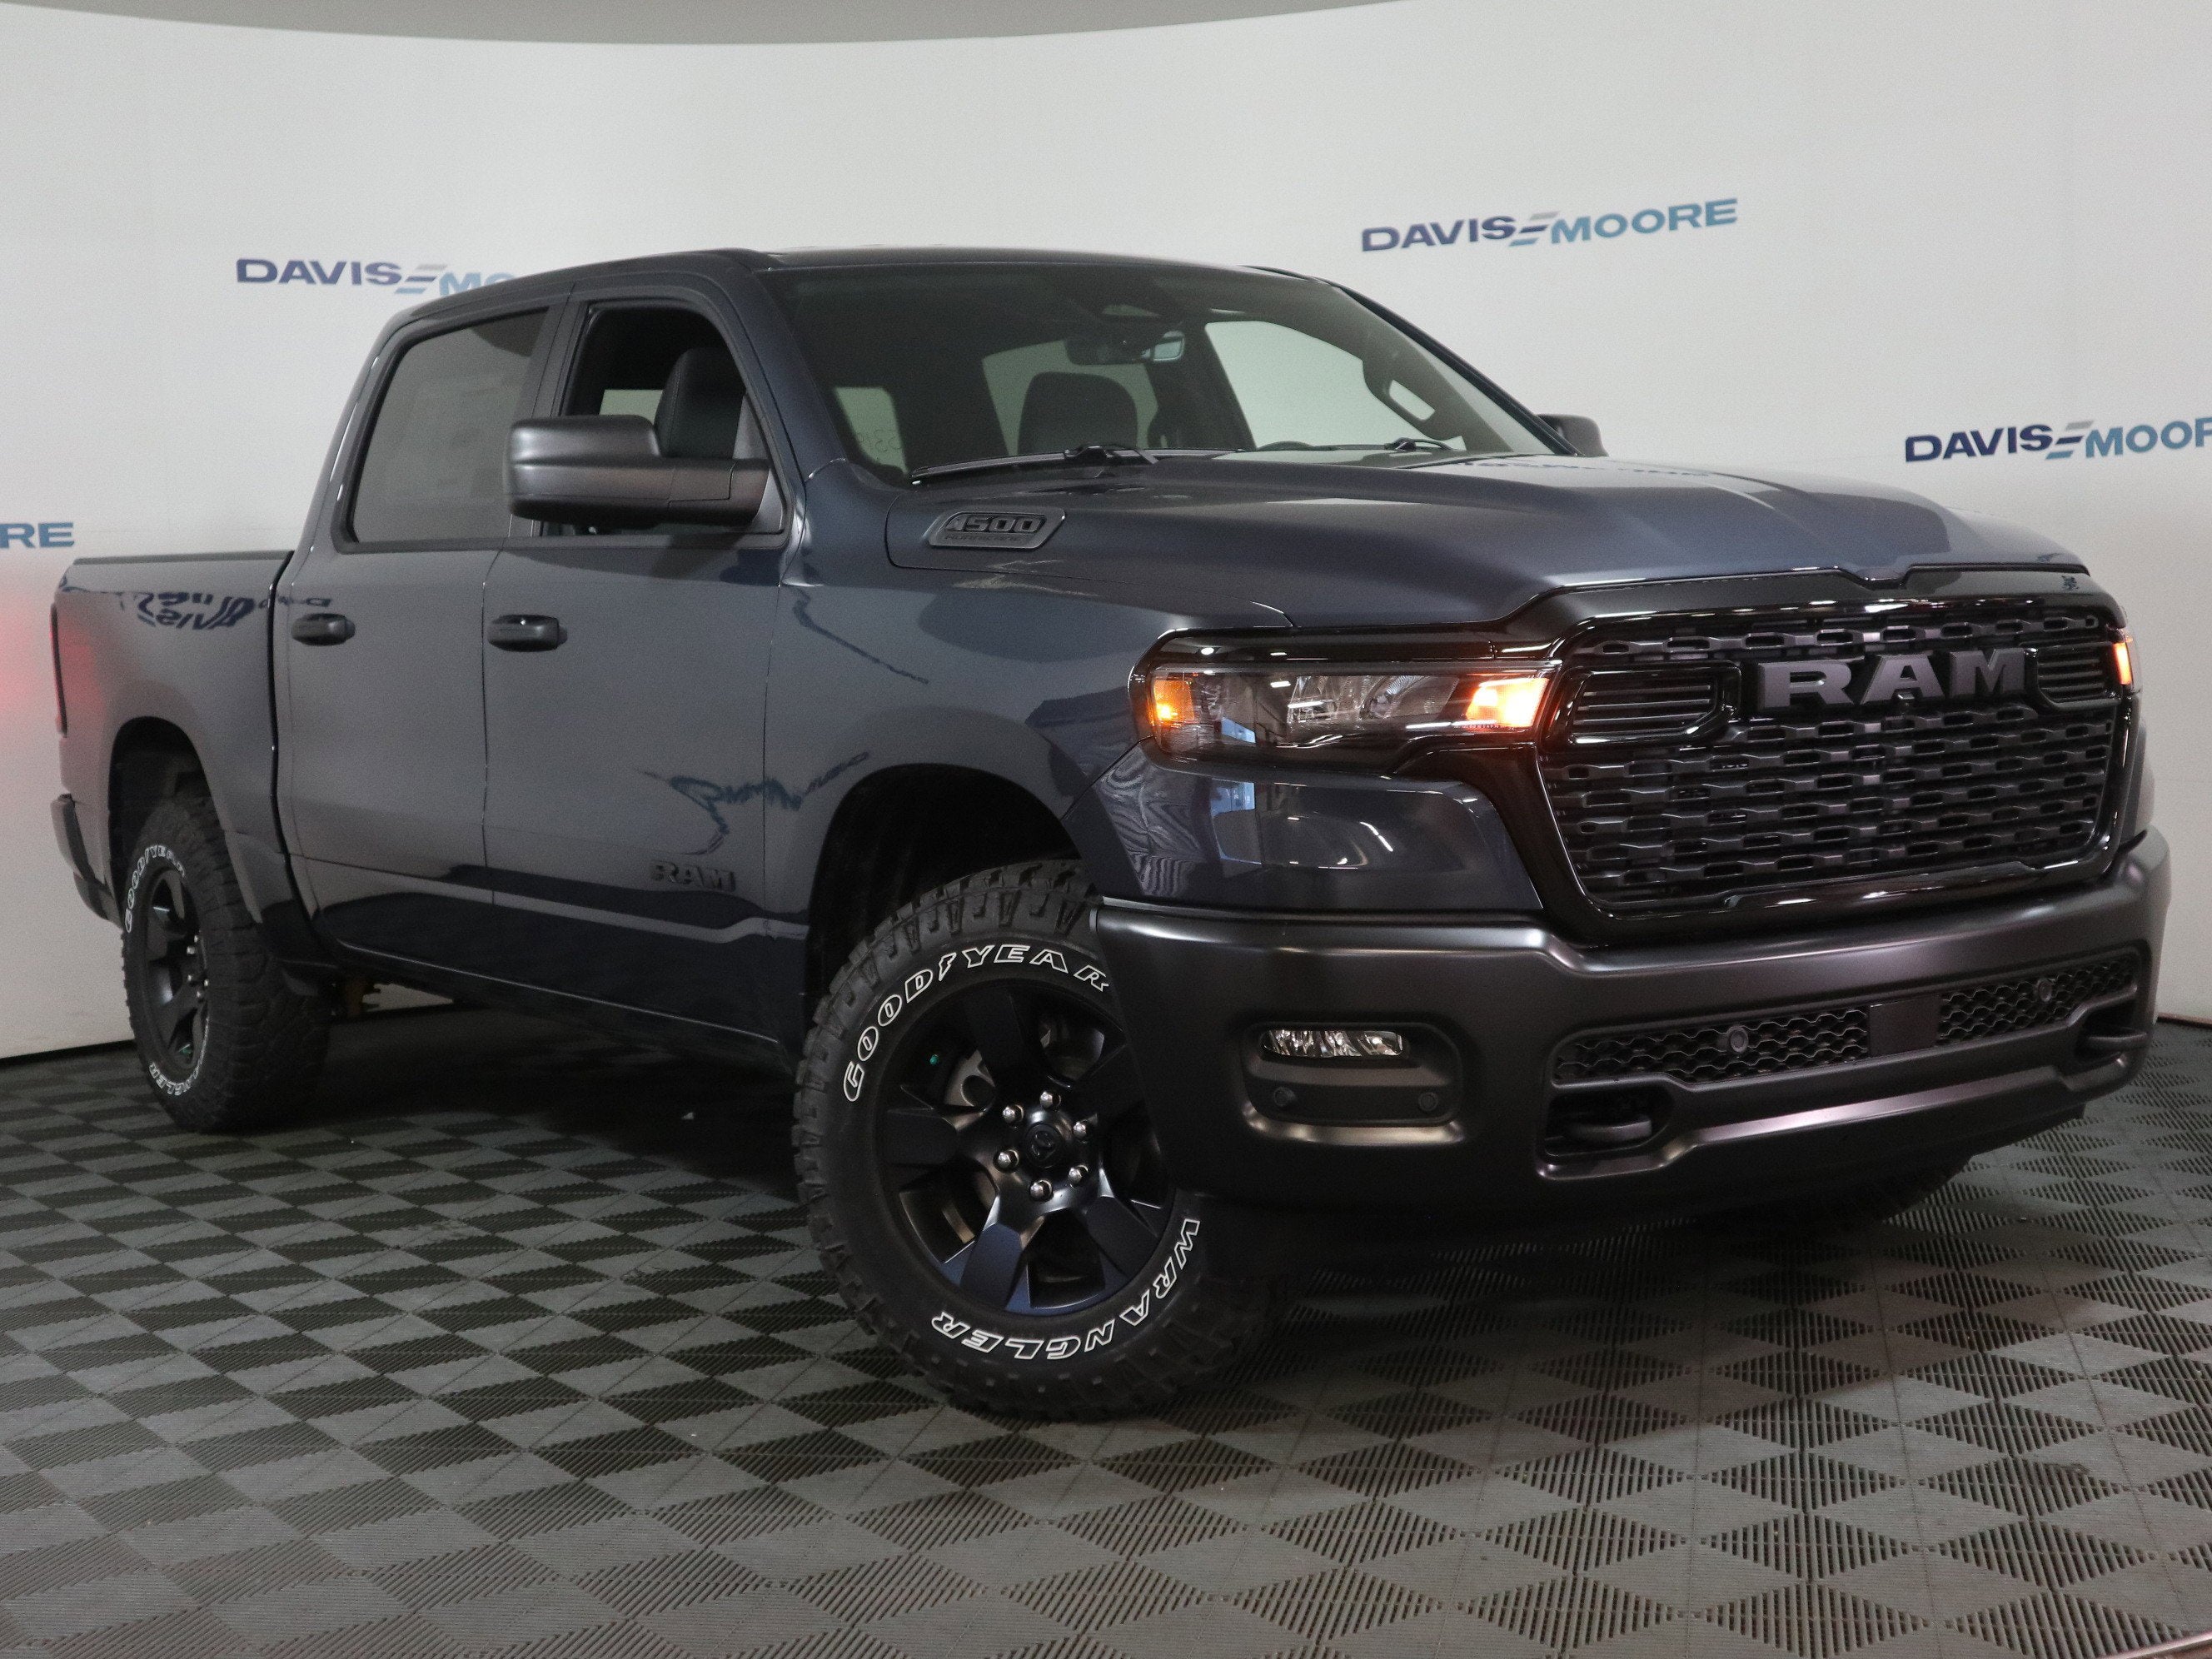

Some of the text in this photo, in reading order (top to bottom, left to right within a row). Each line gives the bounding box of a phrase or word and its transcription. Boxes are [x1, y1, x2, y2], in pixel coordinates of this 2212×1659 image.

[1361, 197, 1739, 252] DAVIS MOORE
[236, 258, 402, 286] DAVIS
[1905, 424, 2054, 462] DAVIS
[945, 514, 1043, 533] 1500
[1757, 646, 2027, 710] RAM
[649, 859, 736, 892] RAM
[842, 944, 1109, 1103] GOODYEAR
[930, 1218, 1201, 1361] WRANGLER
